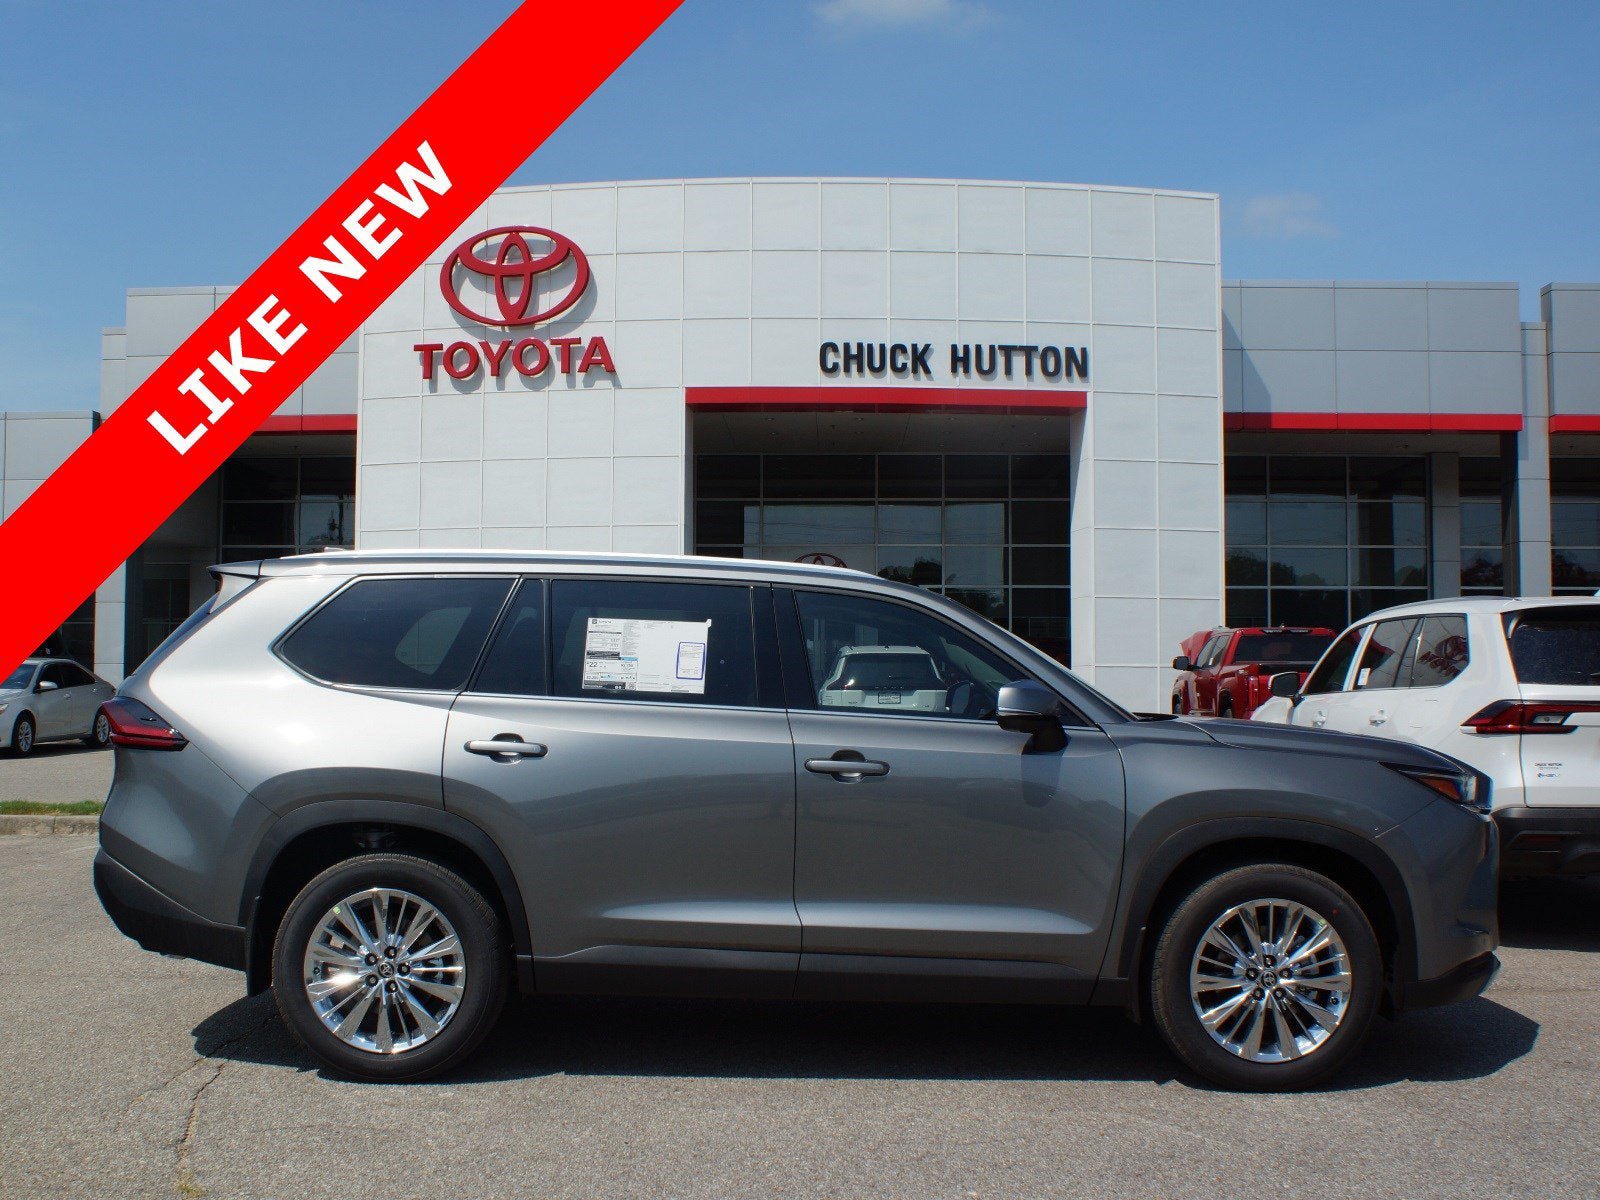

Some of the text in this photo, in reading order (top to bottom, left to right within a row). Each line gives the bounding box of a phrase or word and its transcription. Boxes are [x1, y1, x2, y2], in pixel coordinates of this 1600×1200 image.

[413, 336, 617, 380] TOYOTA
[819, 341, 1088, 378] CHUCK HUTTON
